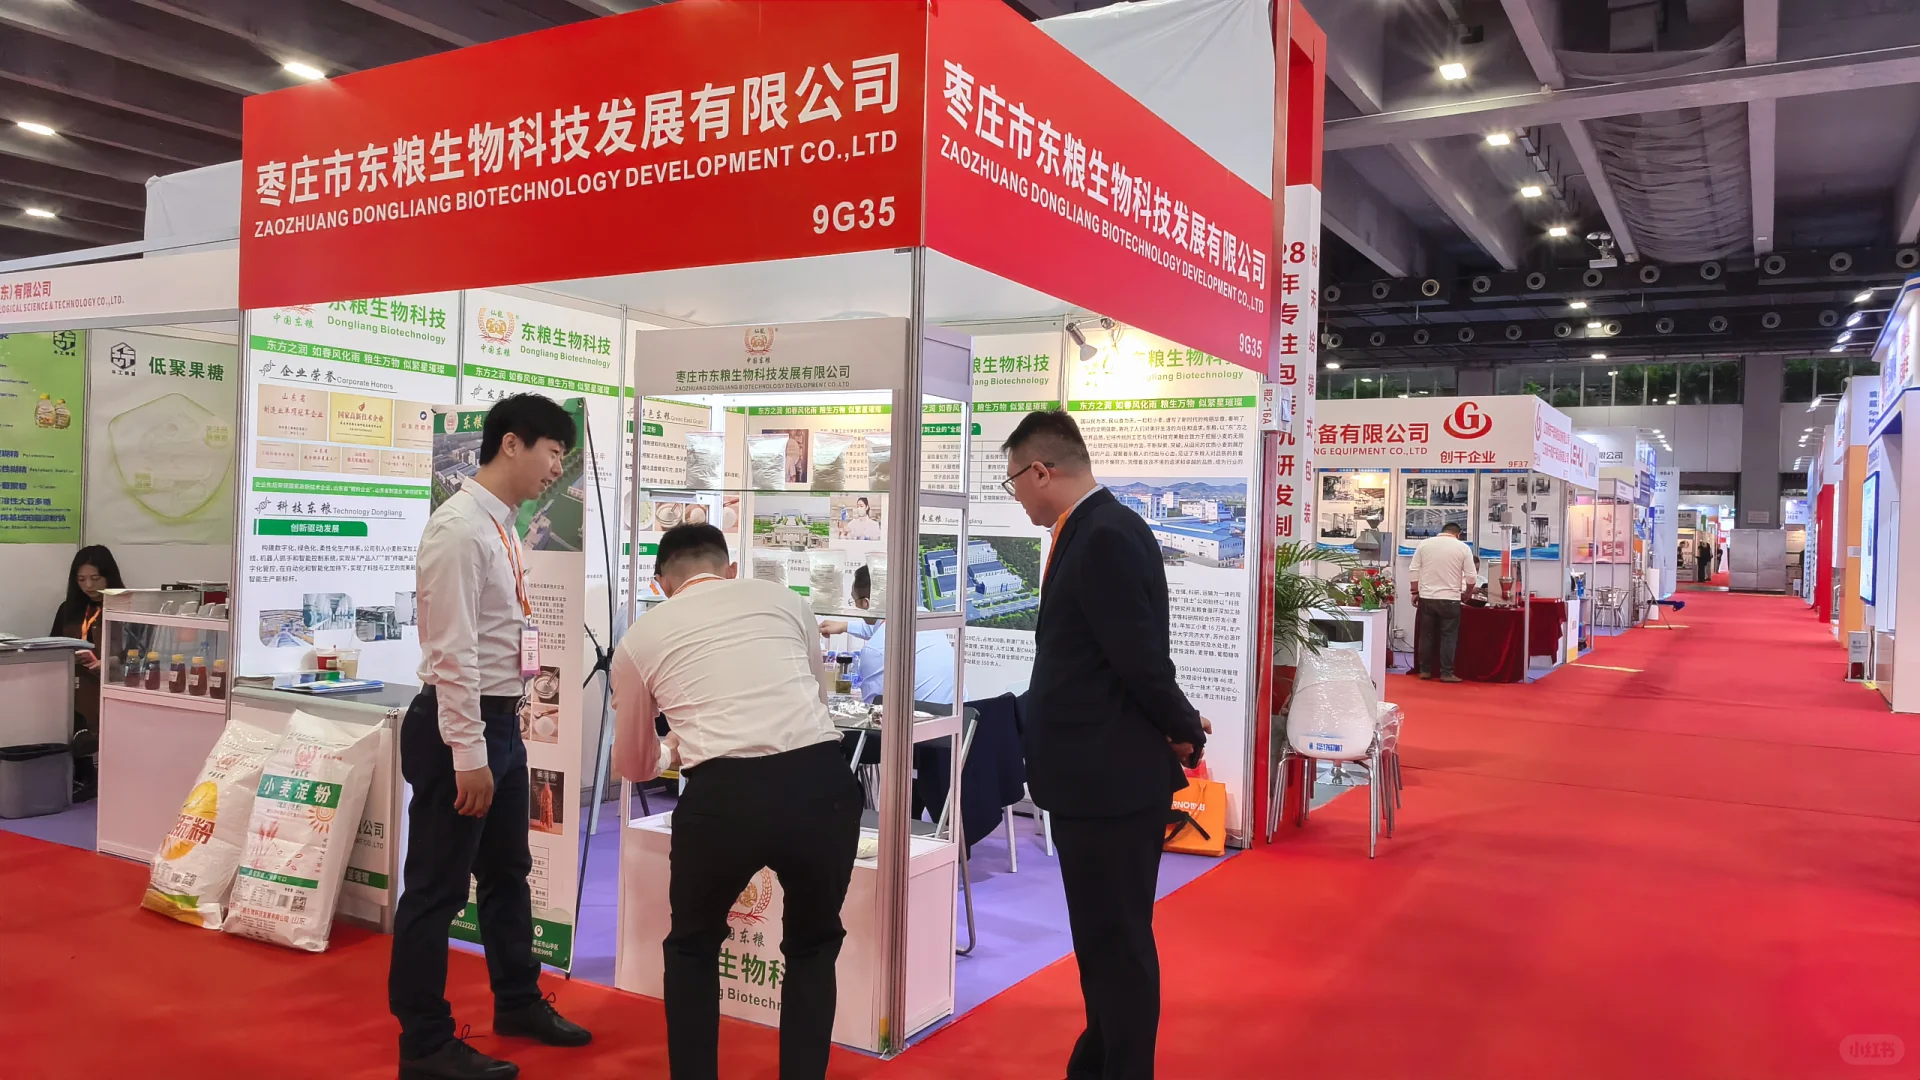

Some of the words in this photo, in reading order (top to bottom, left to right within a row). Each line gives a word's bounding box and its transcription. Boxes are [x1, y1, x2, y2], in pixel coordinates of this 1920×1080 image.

[256, 53, 899, 207] 枣庄市东粮生物科技发展有限公司
[255, 210, 349, 238] ZAOZHUANG
[353, 194, 451, 225] DONGLIANG
[456, 169, 621, 211] BIOTECHNOLOGY
[625, 144, 794, 188] DEVELOPMENT
[800, 129, 897, 164] CO.,LTD
[943, 60, 1265, 290] 枣庄市东粮生物科技发展有限公司
[812, 196, 896, 235] 9G35
[941, 134, 1028, 198] ZAOZHUANG
[1031, 182, 1100, 233] DONGLIANG
[1102, 218, 1181, 274] BIOTECHNOLOGY
[1182, 260, 1237, 301] DEVELOPMENT
[1238, 289, 1264, 314] CO.,LTD
[23, 302, 48, 312] SCIENCE
[54, 297, 96, 310] TECHNOLOGY
[327, 315, 378, 334] Dongliang
[380, 325, 446, 345] Biotechnology
[521, 322, 611, 356] 东粮生物科技
[266, 339, 308, 355] 东方之润
[312, 346, 361, 364] 如春风化雨
[363, 353, 400, 369] 粮生万物
[1238, 332, 1263, 358] 9G35
[520, 345, 559, 361] Dongliang
[560, 351, 611, 369] Biotechnology
[148, 356, 225, 381] 低聚果糖
[280, 364, 337, 384] 企业荣誉
[475, 367, 506, 380] 东方之润
[508, 372, 545, 386] 如春风化雨
[675, 365, 850, 384] 枣庄市东粮生物科技发展有限公司
[1176, 370, 1243, 381] Biotechnology
[336, 376, 370, 388] Corporate
[370, 380, 394, 390] Honors
[739, 382, 785, 390] BIOTECHNOLOGY
[785, 381, 827, 389] DEVELOPMENT
[990, 377, 1049, 386] Biotechnology
[977, 403, 1007, 412] 粮生万物
[1079, 401, 1112, 410] 东方之润
[1160, 399, 1195, 409] 粮生万物
[463, 414, 482, 430] 东粮
[1313, 423, 1429, 445] 备有限公司
[1330, 447, 1386, 456] EQUIPMENT
[1389, 447, 1428, 456] CO.,LTD
[1508, 460, 1529, 468] 9F37
[276, 501, 333, 515] 科技东粮
[333, 507, 370, 517] Technology
[371, 508, 403, 518] Dongliang
[290, 523, 340, 534] 创新驱动发展
[263, 777, 331, 804] 小麦淀粉
[358, 820, 384, 839] 公司
